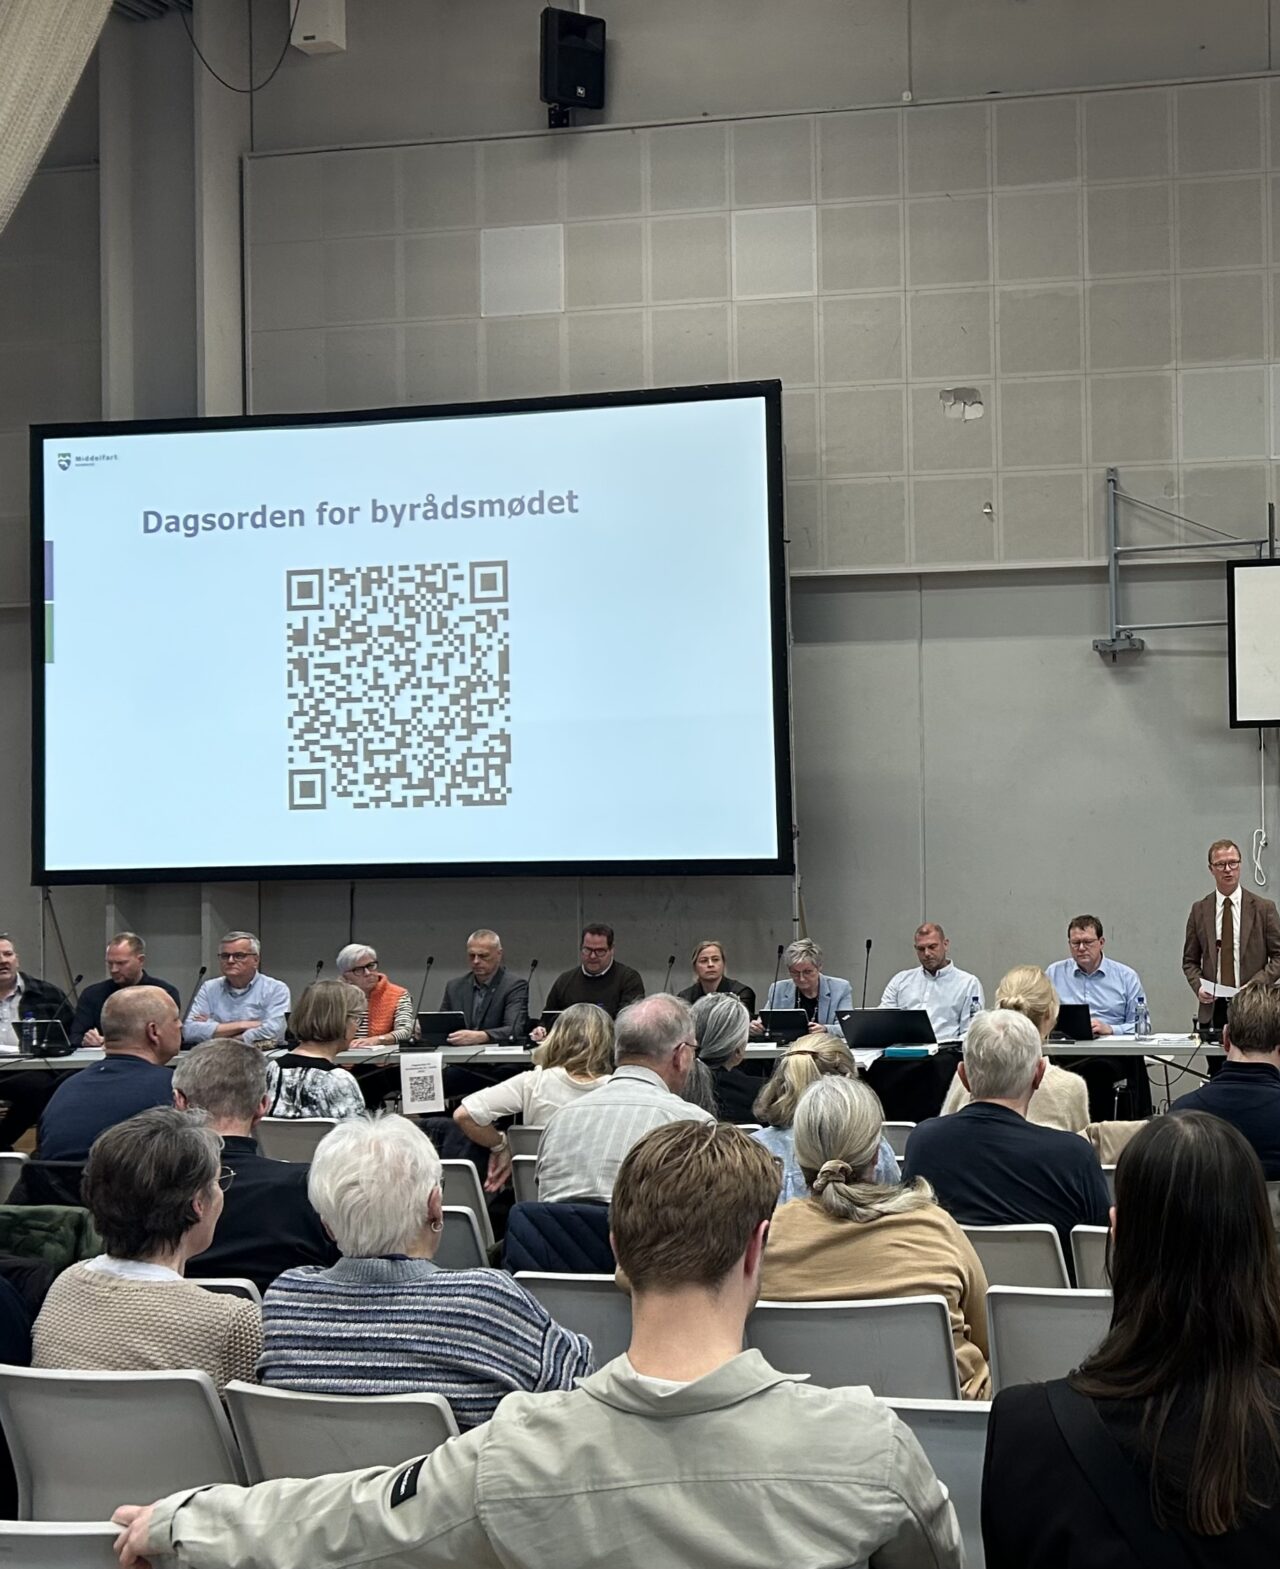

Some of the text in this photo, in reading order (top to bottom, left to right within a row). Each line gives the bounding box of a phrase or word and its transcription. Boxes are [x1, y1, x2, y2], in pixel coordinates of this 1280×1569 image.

[75, 454, 118, 462] Middelfart
[143, 490, 579, 538] Dagsorden for byrådsmødet
